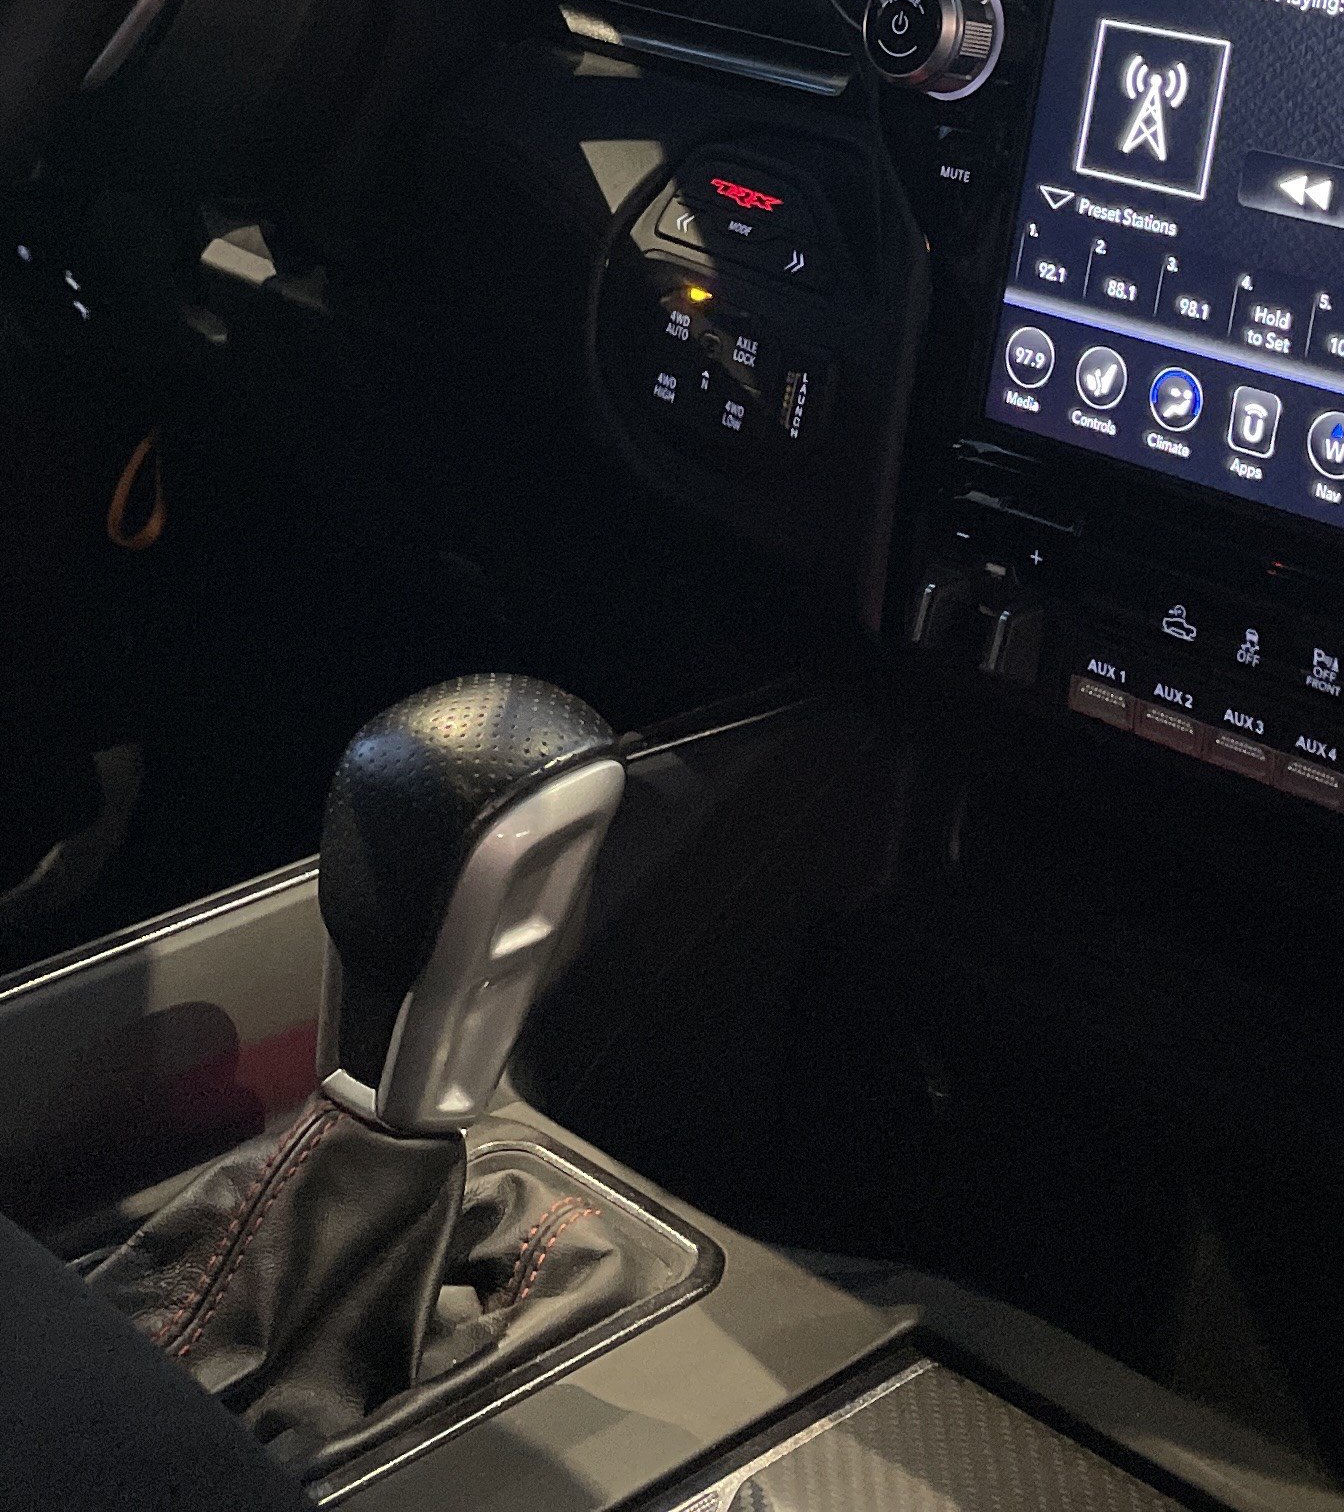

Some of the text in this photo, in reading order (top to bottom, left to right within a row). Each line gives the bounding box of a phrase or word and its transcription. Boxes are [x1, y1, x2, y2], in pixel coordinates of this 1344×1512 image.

[940, 165, 971, 183] MUTE
[710, 178, 784, 212] TRX
[1078, 198, 1178, 236] Preset Stations
[727, 220, 753, 237] MODE
[1038, 261, 1067, 283] 92.1
[1166, 257, 1179, 273] 3.
[1106, 278, 1137, 301] 88.1
[1179, 297, 1209, 320] 98.1
[1318, 293, 1332, 311] 5.
[670, 310, 691, 327] 4WD
[1254, 305, 1292, 330] Hold
[666, 323, 689, 341] AUTO
[1247, 328, 1291, 354] to Set
[735, 336, 758, 355] AXLE
[733, 349, 756, 367] LOCK
[1015, 346, 1045, 368] 97.9
[657, 372, 677, 389] 4WD
[724, 400, 745, 418] 4WD
[789, 372, 809, 439] LAUNCH
[1005, 390, 1041, 413] Media
[721, 415, 742, 432] LOW
[1071, 409, 1117, 437] Controls
[1146, 434, 1190, 459] Climate
[1230, 457, 1264, 481] Apps
[1314, 482, 1342, 504] Nav
[1236, 650, 1261, 668] OFF
[1087, 657, 1128, 684] AUX 1
[1312, 666, 1338, 683] OFF
[1153, 682, 1194, 709] AUX 2
[1306, 675, 1342, 697] FRONT
[1223, 708, 1265, 735] AUX 3
[1295, 734, 1338, 762] AUX 4
